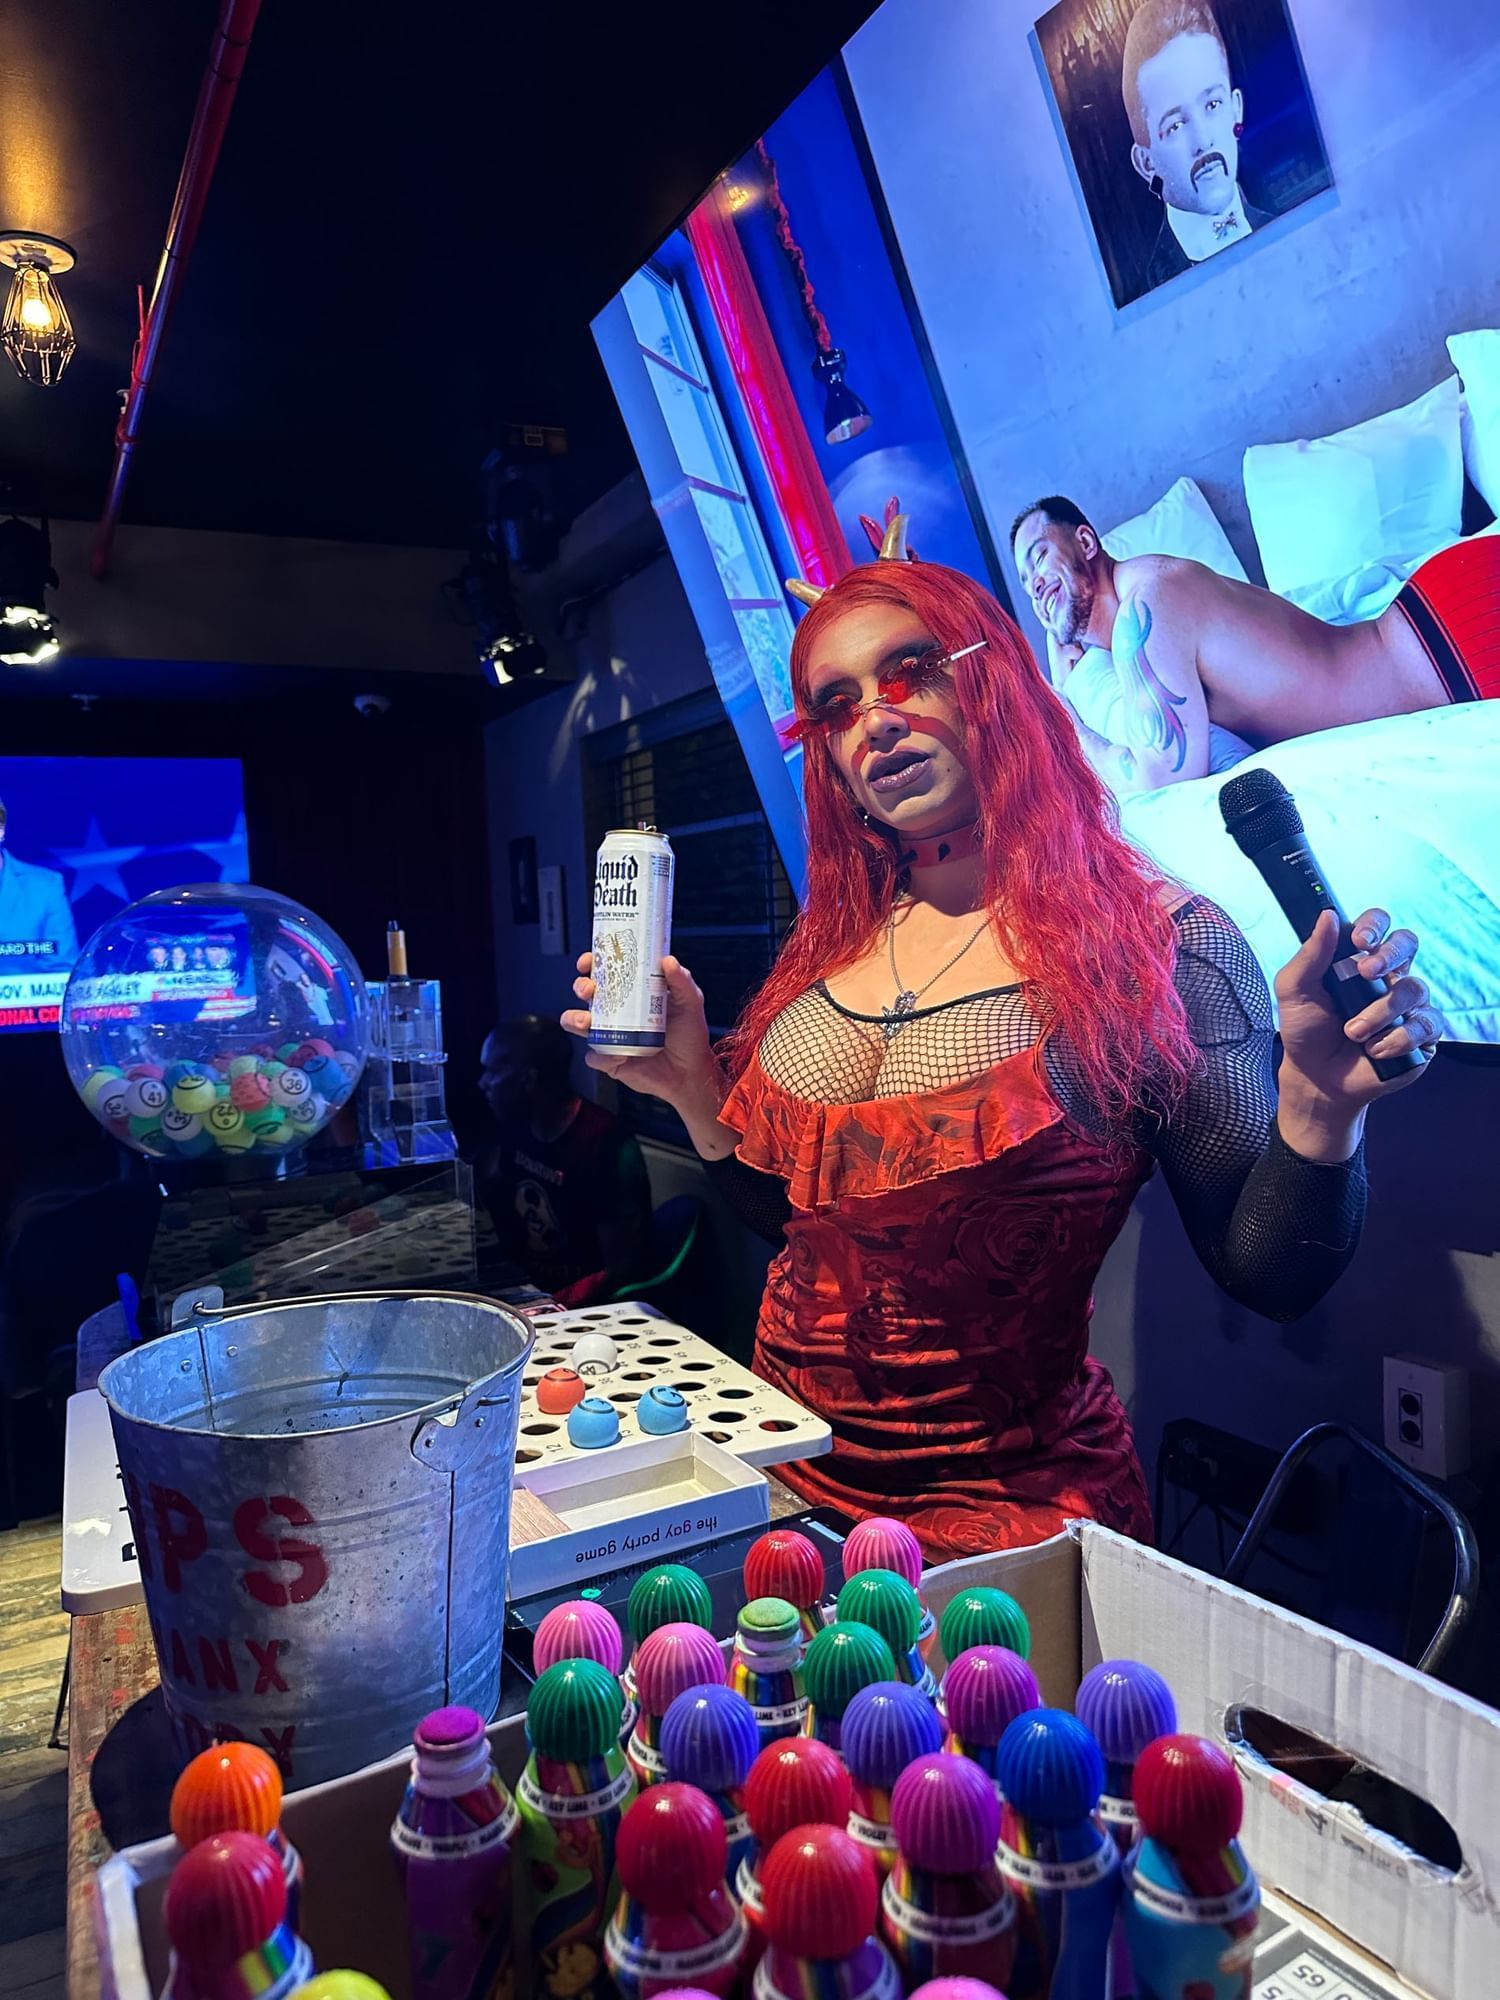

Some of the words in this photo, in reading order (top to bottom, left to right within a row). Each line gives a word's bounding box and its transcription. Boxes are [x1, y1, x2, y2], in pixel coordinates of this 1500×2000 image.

[286, 1078, 303, 1091] 36
[147, 1091, 162, 1103] 41
[664, 1519, 692, 1539] gay
[696, 1516, 718, 1532] the
[621, 1527, 660, 1552] party
[575, 1539, 617, 1562] game
[858, 1825, 887, 1841] VIOLET
[1292, 1963, 1326, 1989] 65
